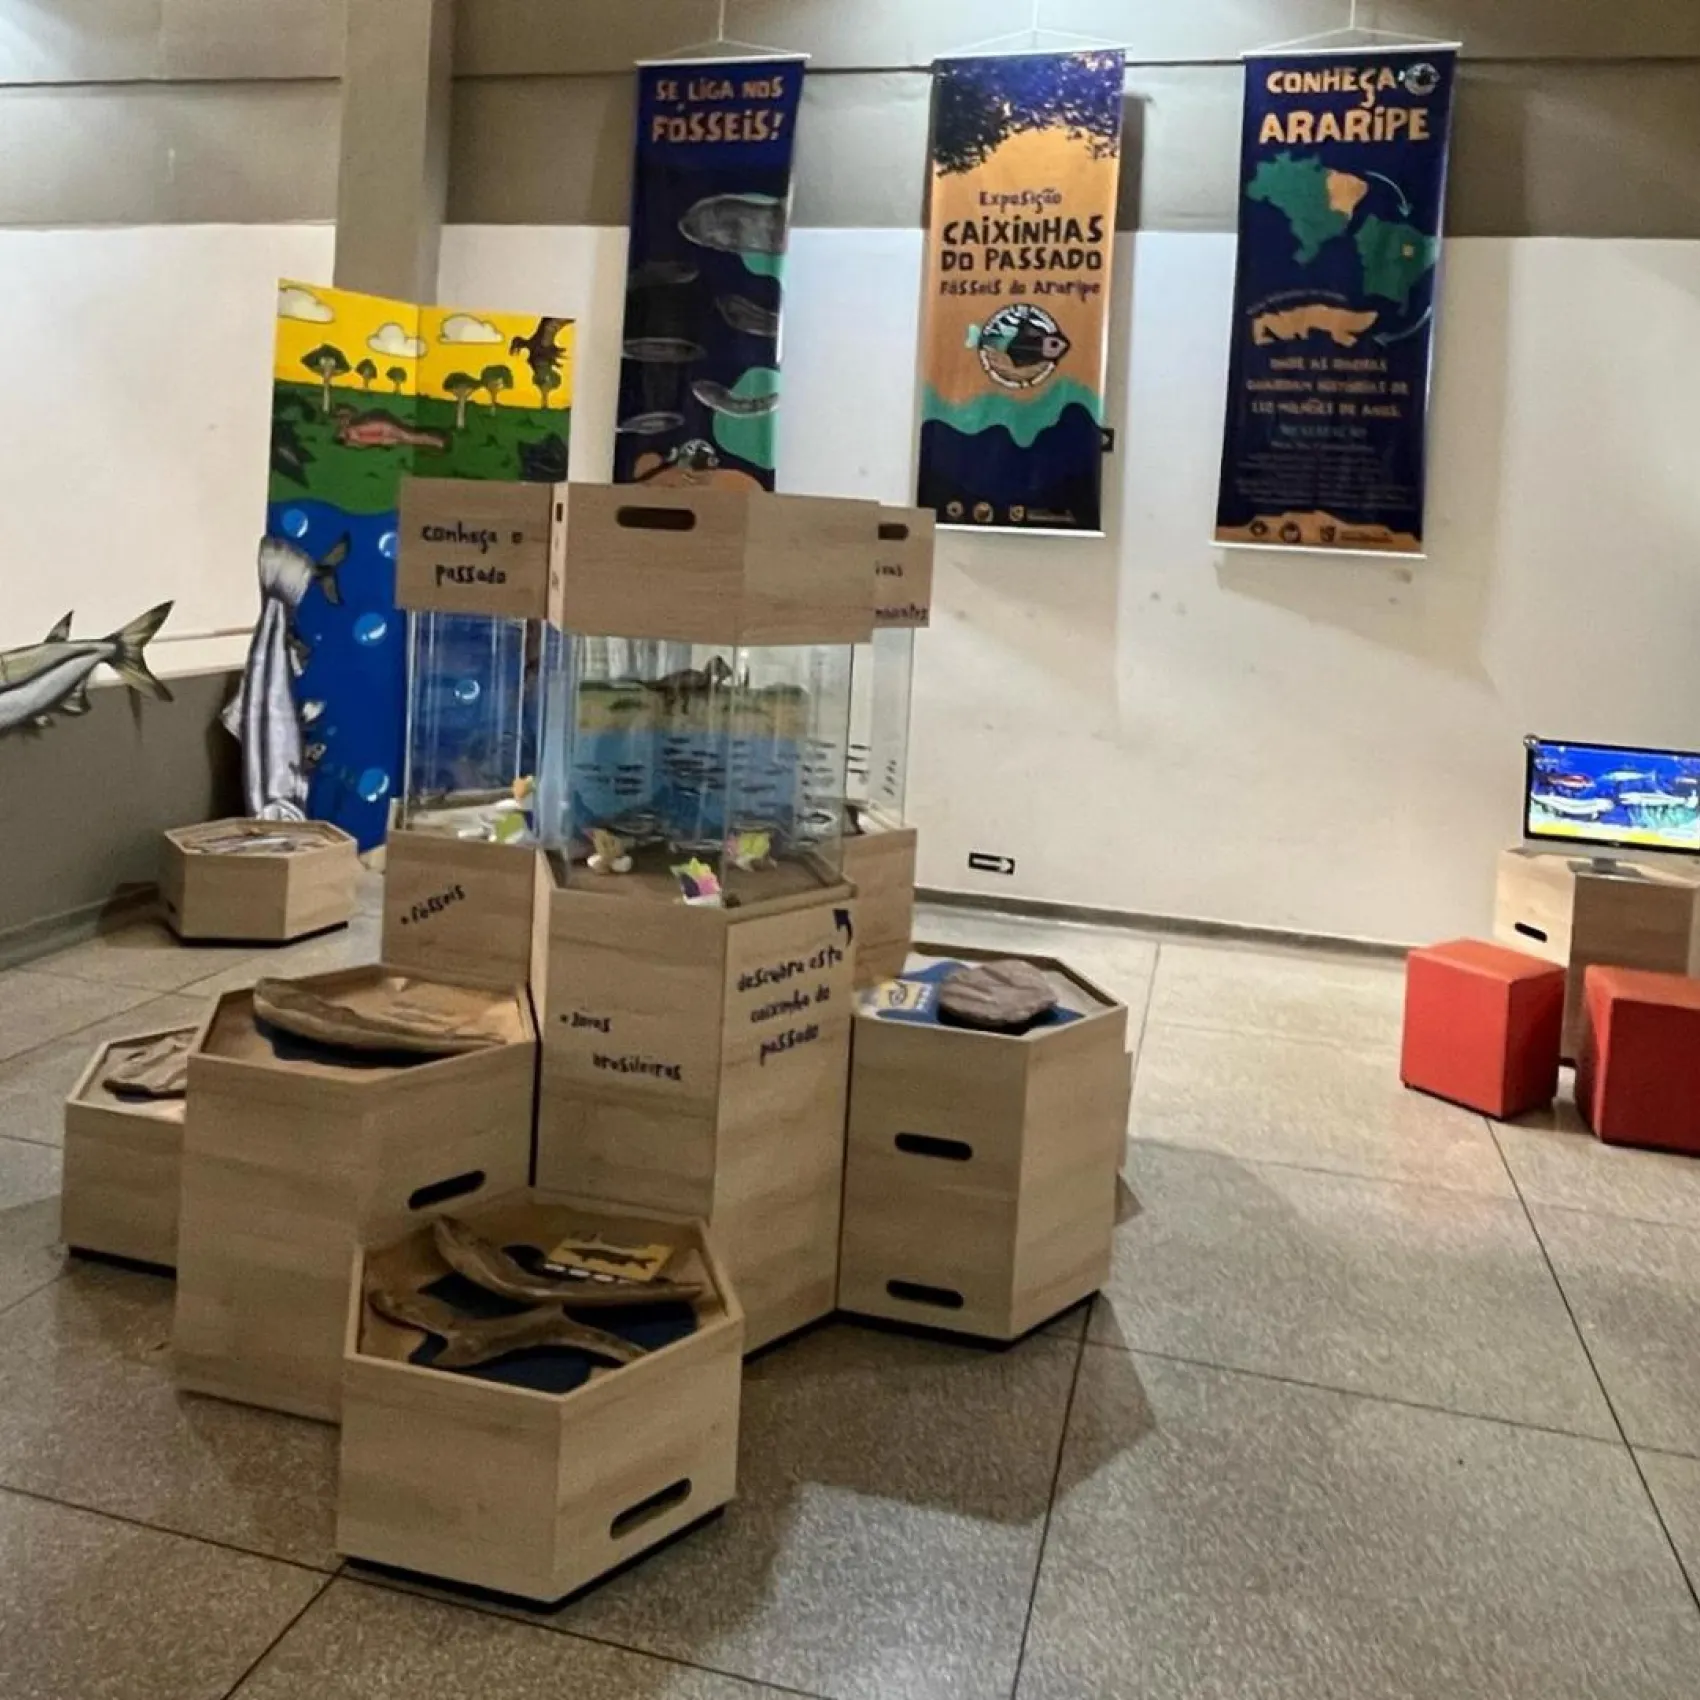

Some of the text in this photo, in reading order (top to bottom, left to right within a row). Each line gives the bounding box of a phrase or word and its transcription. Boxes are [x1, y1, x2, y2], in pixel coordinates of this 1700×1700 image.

[656, 80, 679, 101] SE
[742, 76, 784, 99] NOS
[1266, 67, 1398, 108] CONHEÇA
[979, 188, 1063, 214] Exposição
[940, 247, 1104, 272] DO PASSADO
[421, 520, 498, 555] conheça
[435, 564, 507, 587] passado
[737, 960, 805, 993] descubra
[760, 1024, 819, 1067] passado
